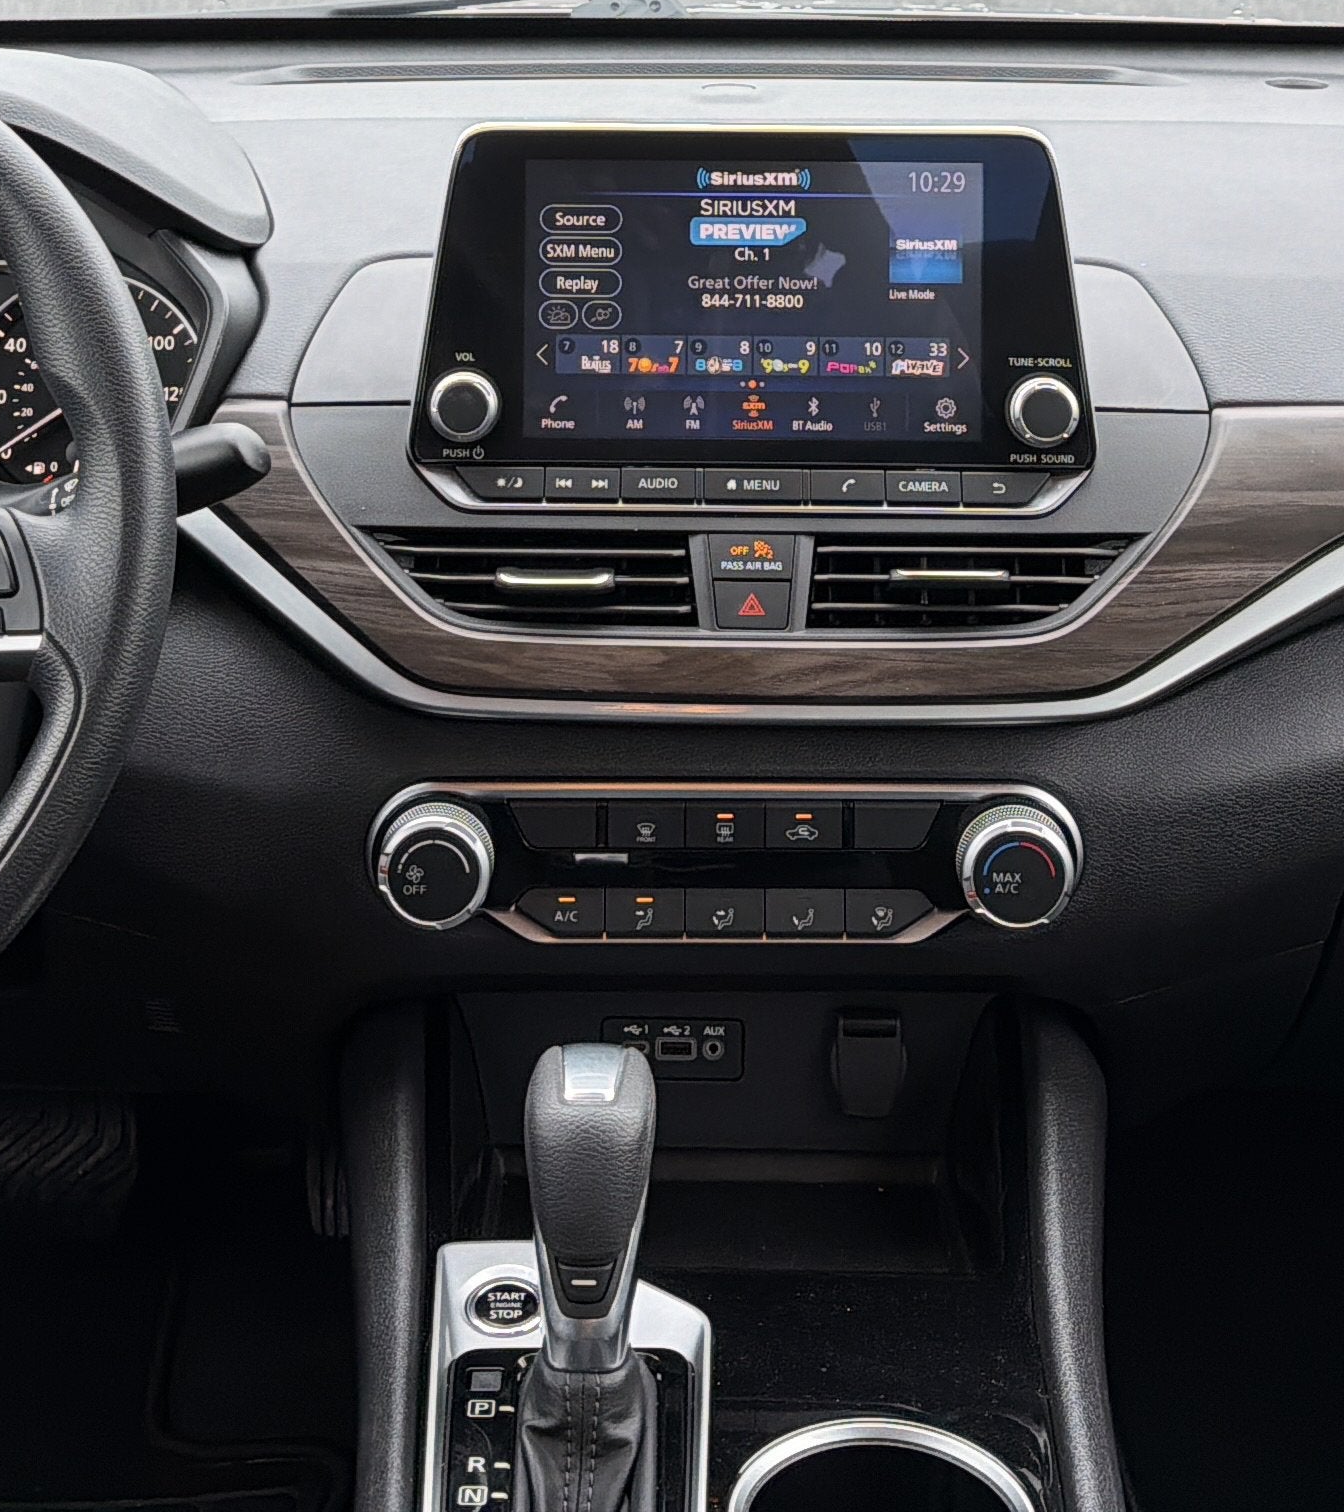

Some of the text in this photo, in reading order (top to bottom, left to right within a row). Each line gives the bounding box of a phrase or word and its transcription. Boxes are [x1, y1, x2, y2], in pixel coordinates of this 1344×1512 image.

[908, 171, 966, 193] 10:29
[700, 199, 795, 216] SIRIUSXM
[555, 212, 606, 226] Source
[699, 223, 797, 240] PREVIEW
[895, 239, 958, 251] SiriusXM
[546, 244, 615, 258] SXM Menu
[734, 247, 770, 261] Ch. 1
[556, 276, 599, 292] Replay
[688, 276, 817, 290] Great Offer Now!
[889, 289, 936, 300] Live Mode
[701, 295, 804, 308] 844-711-8800
[4, 337, 27, 353] 40
[147, 335, 175, 351] 100
[601, 339, 619, 354] 18
[674, 340, 684, 354] 7
[739, 340, 750, 355] 8
[758, 343, 771, 353] 10
[805, 341, 816, 356] 9
[824, 343, 837, 353] 11
[864, 342, 882, 356] 10
[890, 344, 904, 355] 12
[928, 342, 948, 357] 33
[455, 352, 475, 362] VOL
[20, 383, 34, 392] 40
[163, 386, 183, 402] 12
[20, 407, 34, 417] 20
[541, 418, 575, 429] Phone
[626, 419, 643, 429] AM
[685, 419, 700, 429] FM
[732, 420, 773, 430] SiriusXM
[792, 420, 833, 431] BT Audio
[864, 421, 887, 431] USB1
[923, 422, 967, 434] Settings
[443, 448, 470, 458] PUSH
[1010, 454, 1075, 465] PUSH SOUND
[638, 478, 678, 489] AUDIO
[743, 479, 780, 490] MENU
[898, 481, 948, 493] CAMERA
[729, 546, 750, 556] OFF
[721, 561, 783, 571] PASS AIR BAG
[992, 872, 1022, 883] MAX
[403, 884, 427, 895] OFF
[994, 883, 1019, 894] A/C
[554, 910, 579, 923] A/C
[683, 1025, 691, 1035] 2
[703, 1026, 725, 1036] AUX
[487, 1292, 527, 1301] START
[489, 1309, 523, 1320] STOP
[474, 1402, 490, 1415] P
[467, 1456, 486, 1473] R
[464, 1488, 482, 1503] N
